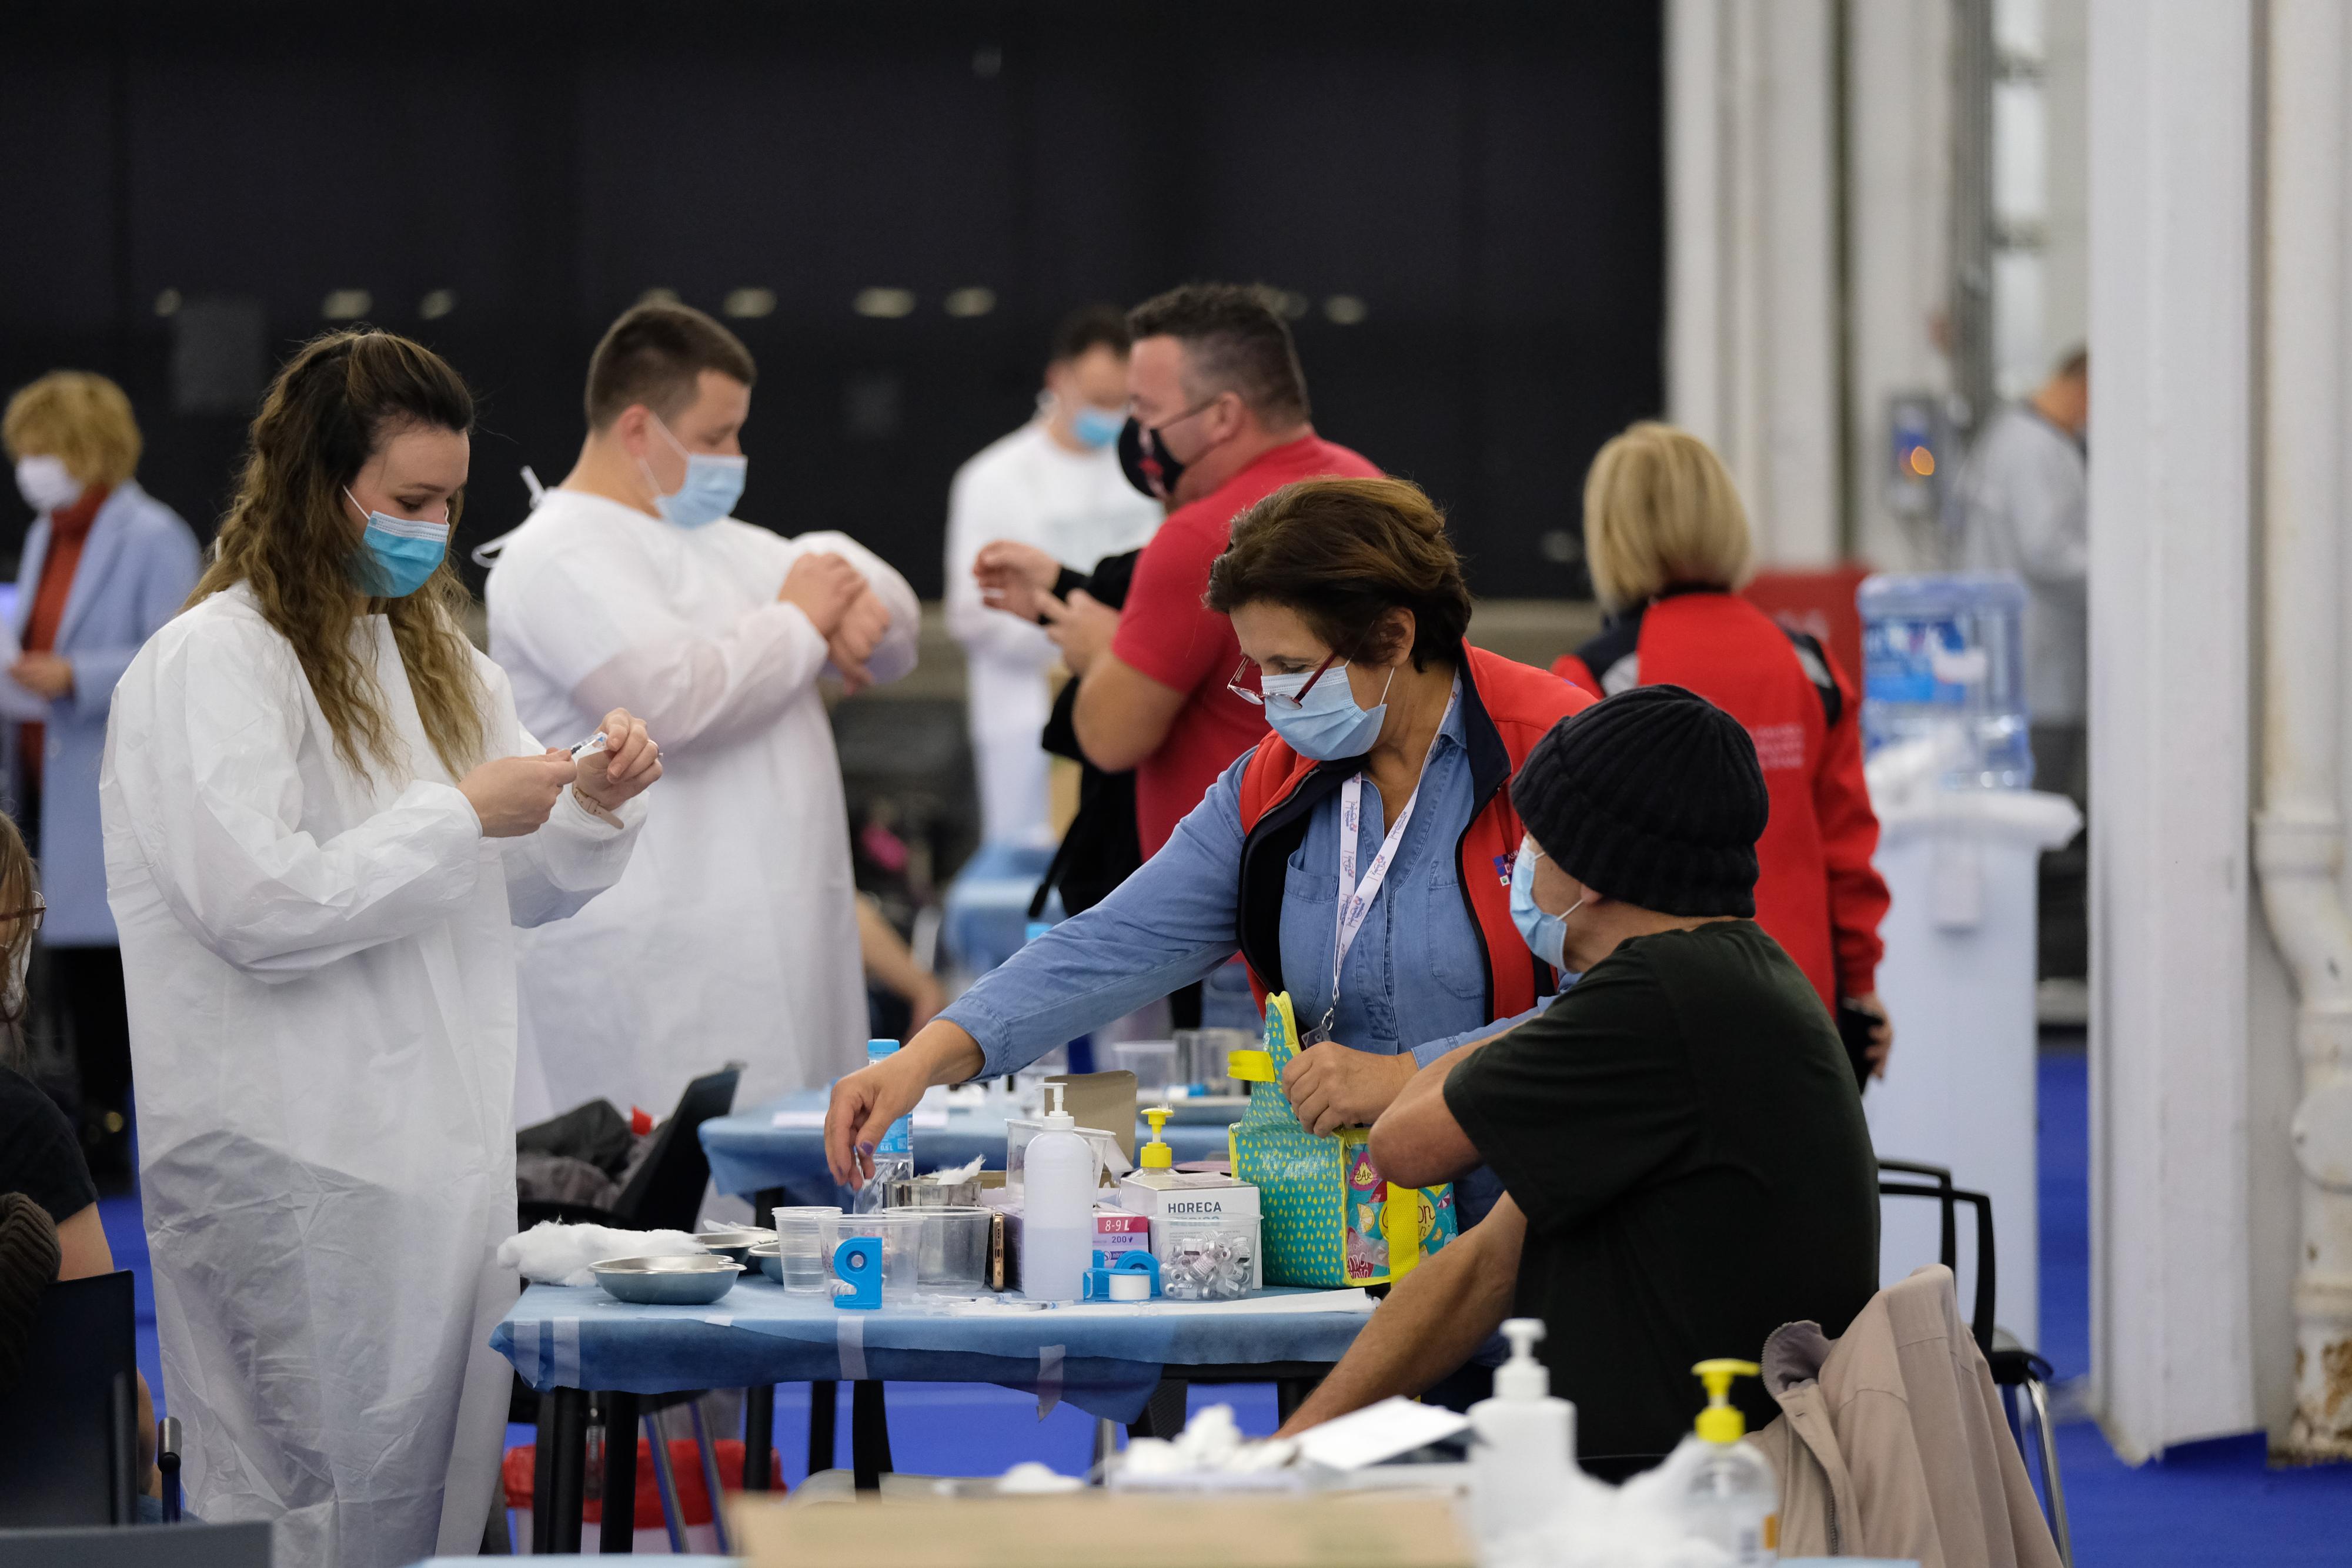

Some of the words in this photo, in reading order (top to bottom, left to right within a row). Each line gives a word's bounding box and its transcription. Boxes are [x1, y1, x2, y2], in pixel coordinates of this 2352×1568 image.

[1168, 1202, 1222, 1213] HORECA
[1105, 1219, 1121, 1232] 8-9
[1124, 1219, 1130, 1231] L
